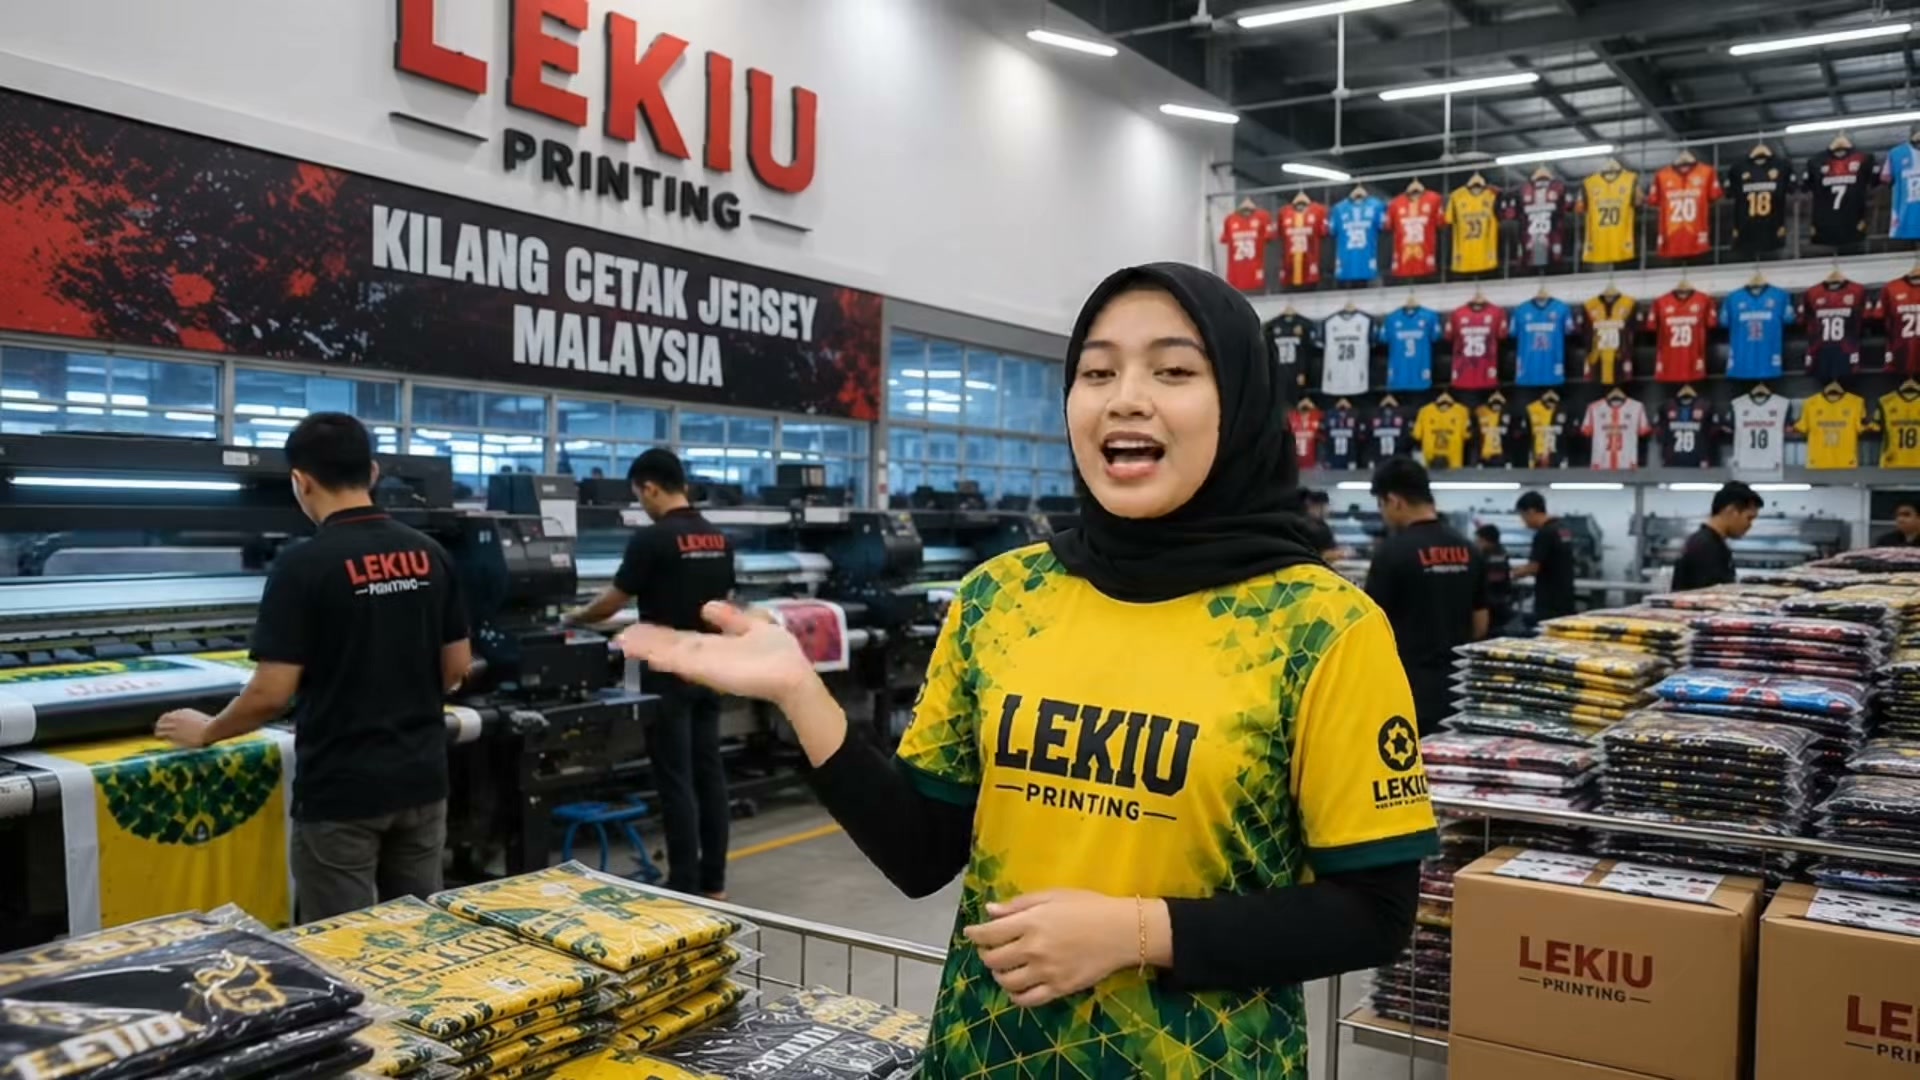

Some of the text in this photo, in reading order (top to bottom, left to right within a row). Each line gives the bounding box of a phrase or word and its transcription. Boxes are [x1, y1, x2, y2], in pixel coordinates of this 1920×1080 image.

[394, 0, 818, 193] LEKIU
[503, 128, 741, 229] PRINTING
[1831, 185, 1847, 210] 7
[1598, 207, 1621, 226] 20
[1670, 198, 1697, 223] 20
[1746, 191, 1772, 217] 18
[372, 205, 818, 342] KILANG CETAK JERSEY
[512, 305, 724, 388] MALAYSIA
[1821, 317, 1845, 341] 18
[345, 550, 430, 585] LEKIU
[995, 693, 1200, 797] LEKIU
[1026, 783, 1140, 821] PRINTING
[1519, 935, 1654, 989] LEKIU
[1542, 977, 1626, 1003] PRINTING
[1847, 994, 1920, 1043] LE
